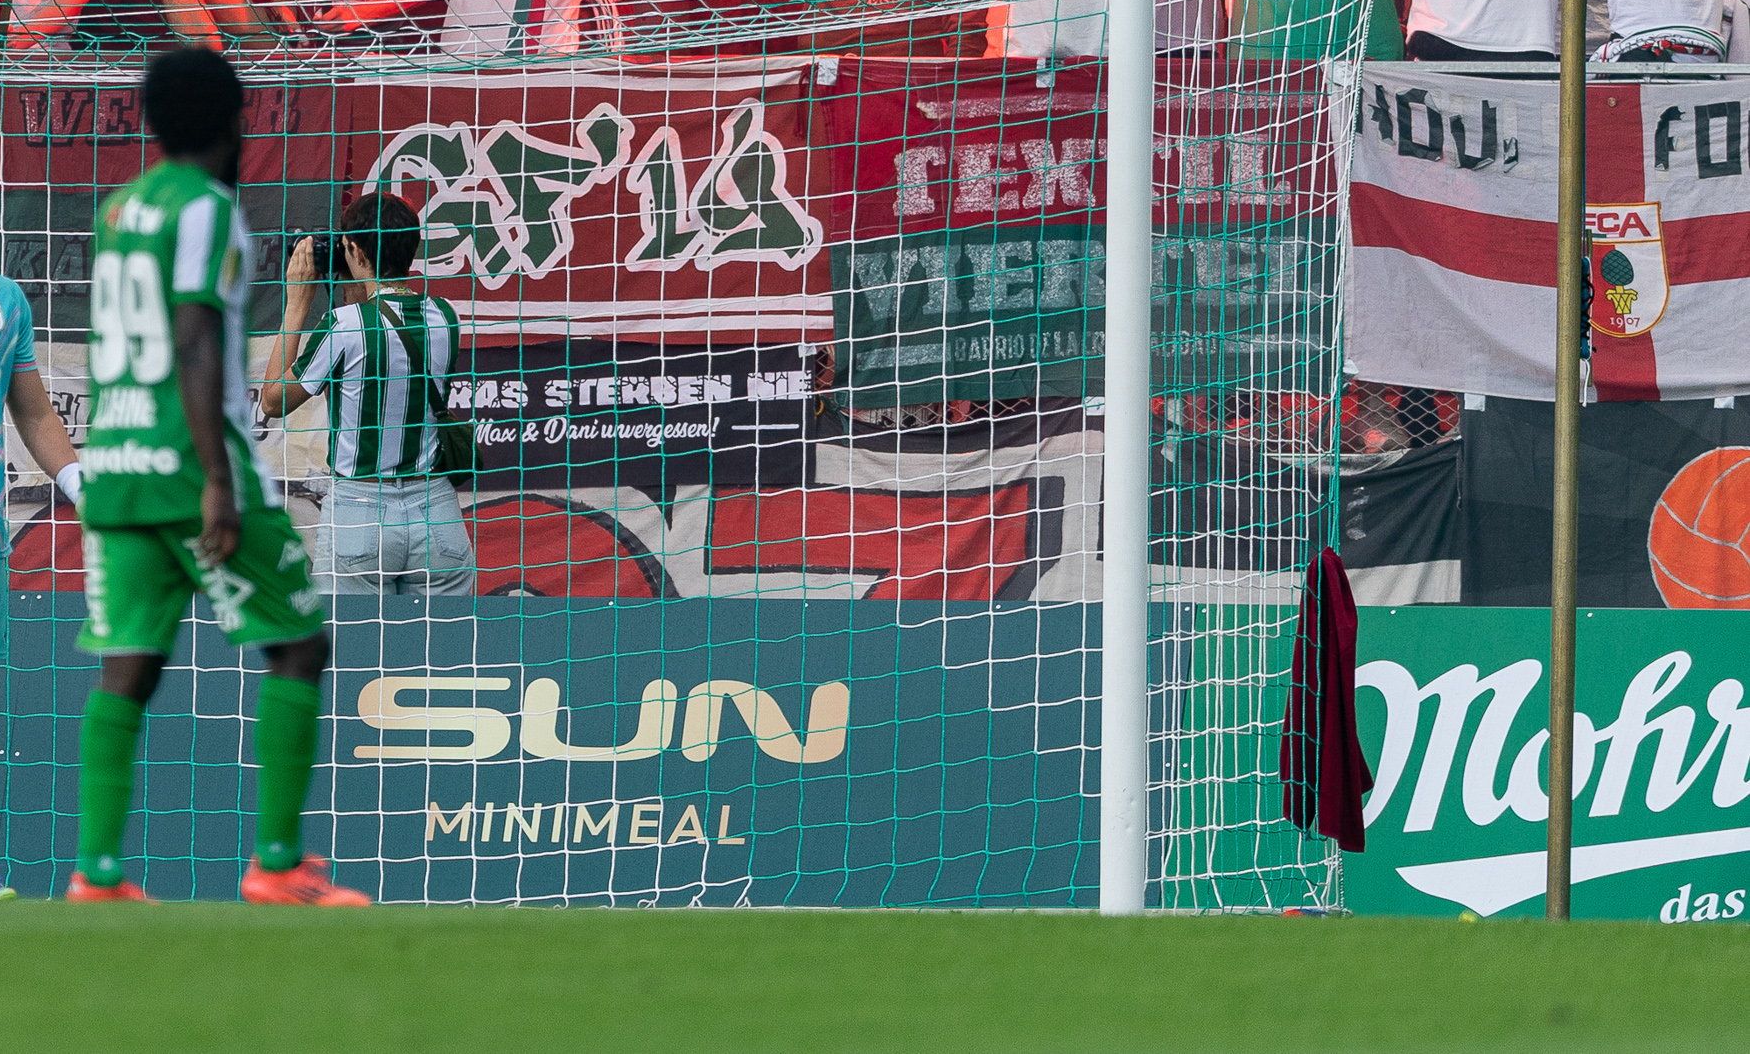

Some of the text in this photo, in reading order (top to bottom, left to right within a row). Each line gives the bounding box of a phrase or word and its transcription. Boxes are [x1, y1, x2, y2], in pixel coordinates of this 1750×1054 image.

[90, 248, 177, 387] 99
[1609, 316, 1641, 328] 1907
[544, 373, 733, 408] STERBEN
[747, 369, 813, 402] NIE
[474, 415, 722, 449] Max & Dani unvergessen!
[352, 675, 851, 764] SUN
[425, 800, 746, 845] MINIMEAL
[1659, 882, 1747, 925] das
